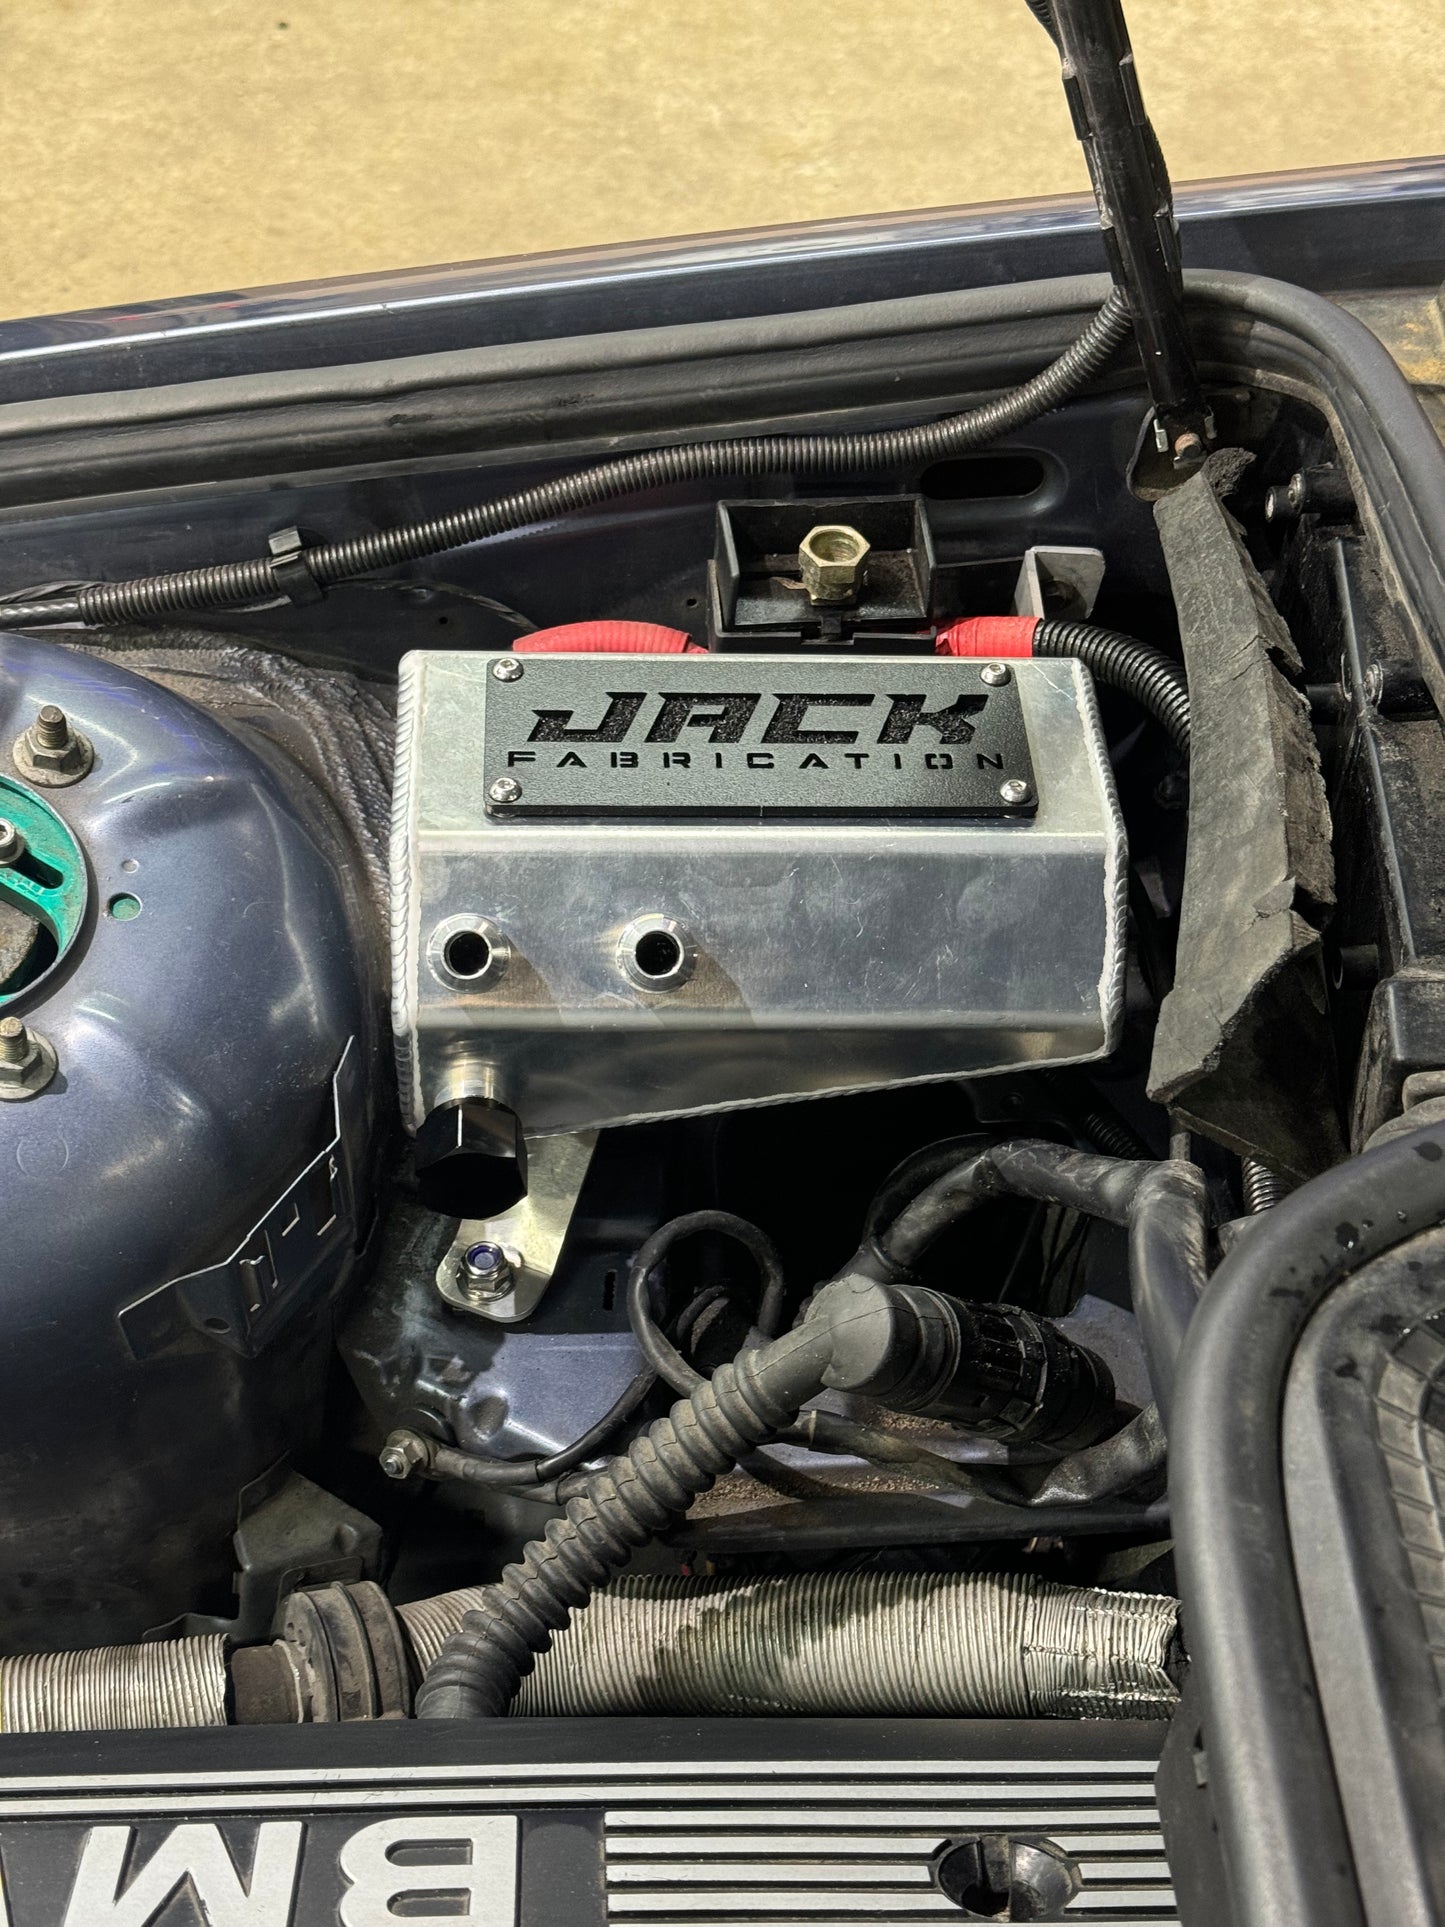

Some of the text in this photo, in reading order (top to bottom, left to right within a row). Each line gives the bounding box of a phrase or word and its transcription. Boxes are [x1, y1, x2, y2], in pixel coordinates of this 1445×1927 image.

[528, 692, 988, 744] JACK
[507, 752, 1004, 769] FABRICATION
[0, 1815, 518, 1927] BM
